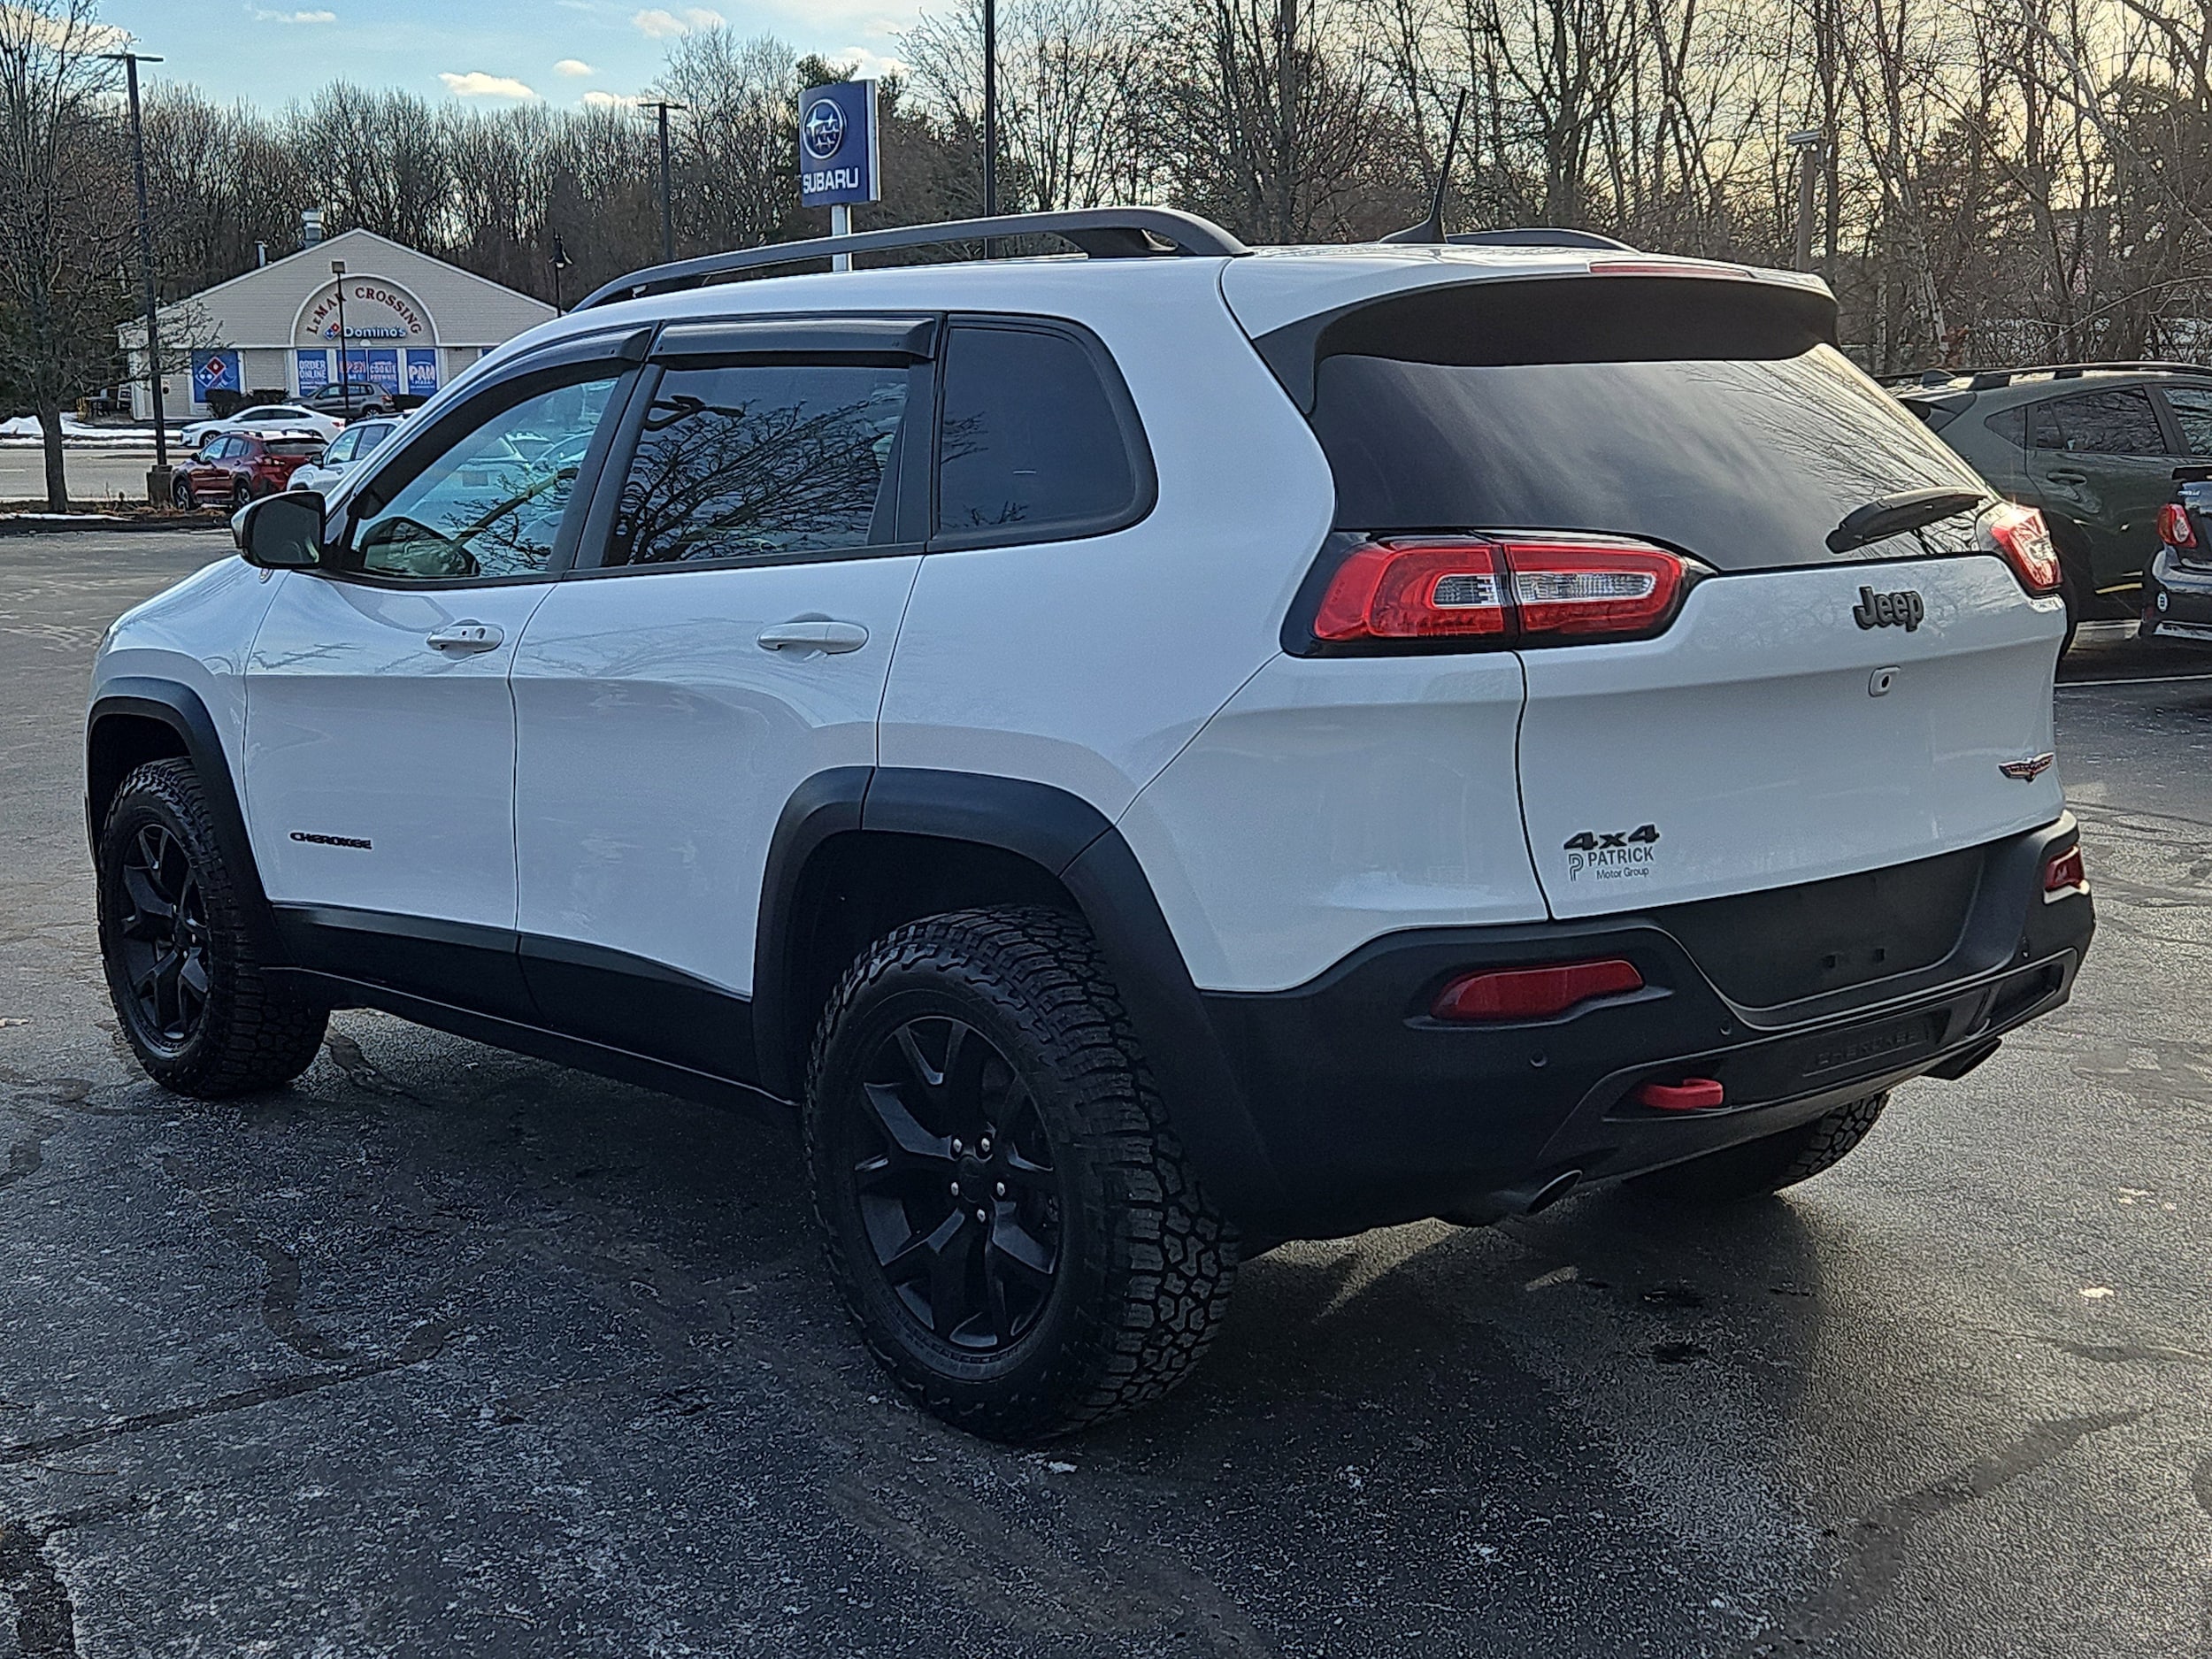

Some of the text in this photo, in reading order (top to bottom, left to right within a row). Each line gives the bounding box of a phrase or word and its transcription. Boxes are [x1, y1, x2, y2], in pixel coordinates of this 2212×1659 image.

[803, 167, 858, 193] SUBARU
[355, 287, 422, 334] CROSSING
[344, 326, 406, 337] Domino's
[299, 360, 326, 370] ORDER
[370, 364, 396, 373] COOKIE
[408, 365, 435, 380] PAN
[299, 369, 326, 379] ONLINE
[1854, 586, 1924, 632] Jeep
[290, 833, 372, 849] CHEROKEE
[1563, 824, 1660, 850] 4x4
[1588, 847, 1654, 867] PATRICK
[1596, 867, 1649, 880] Motor Group
